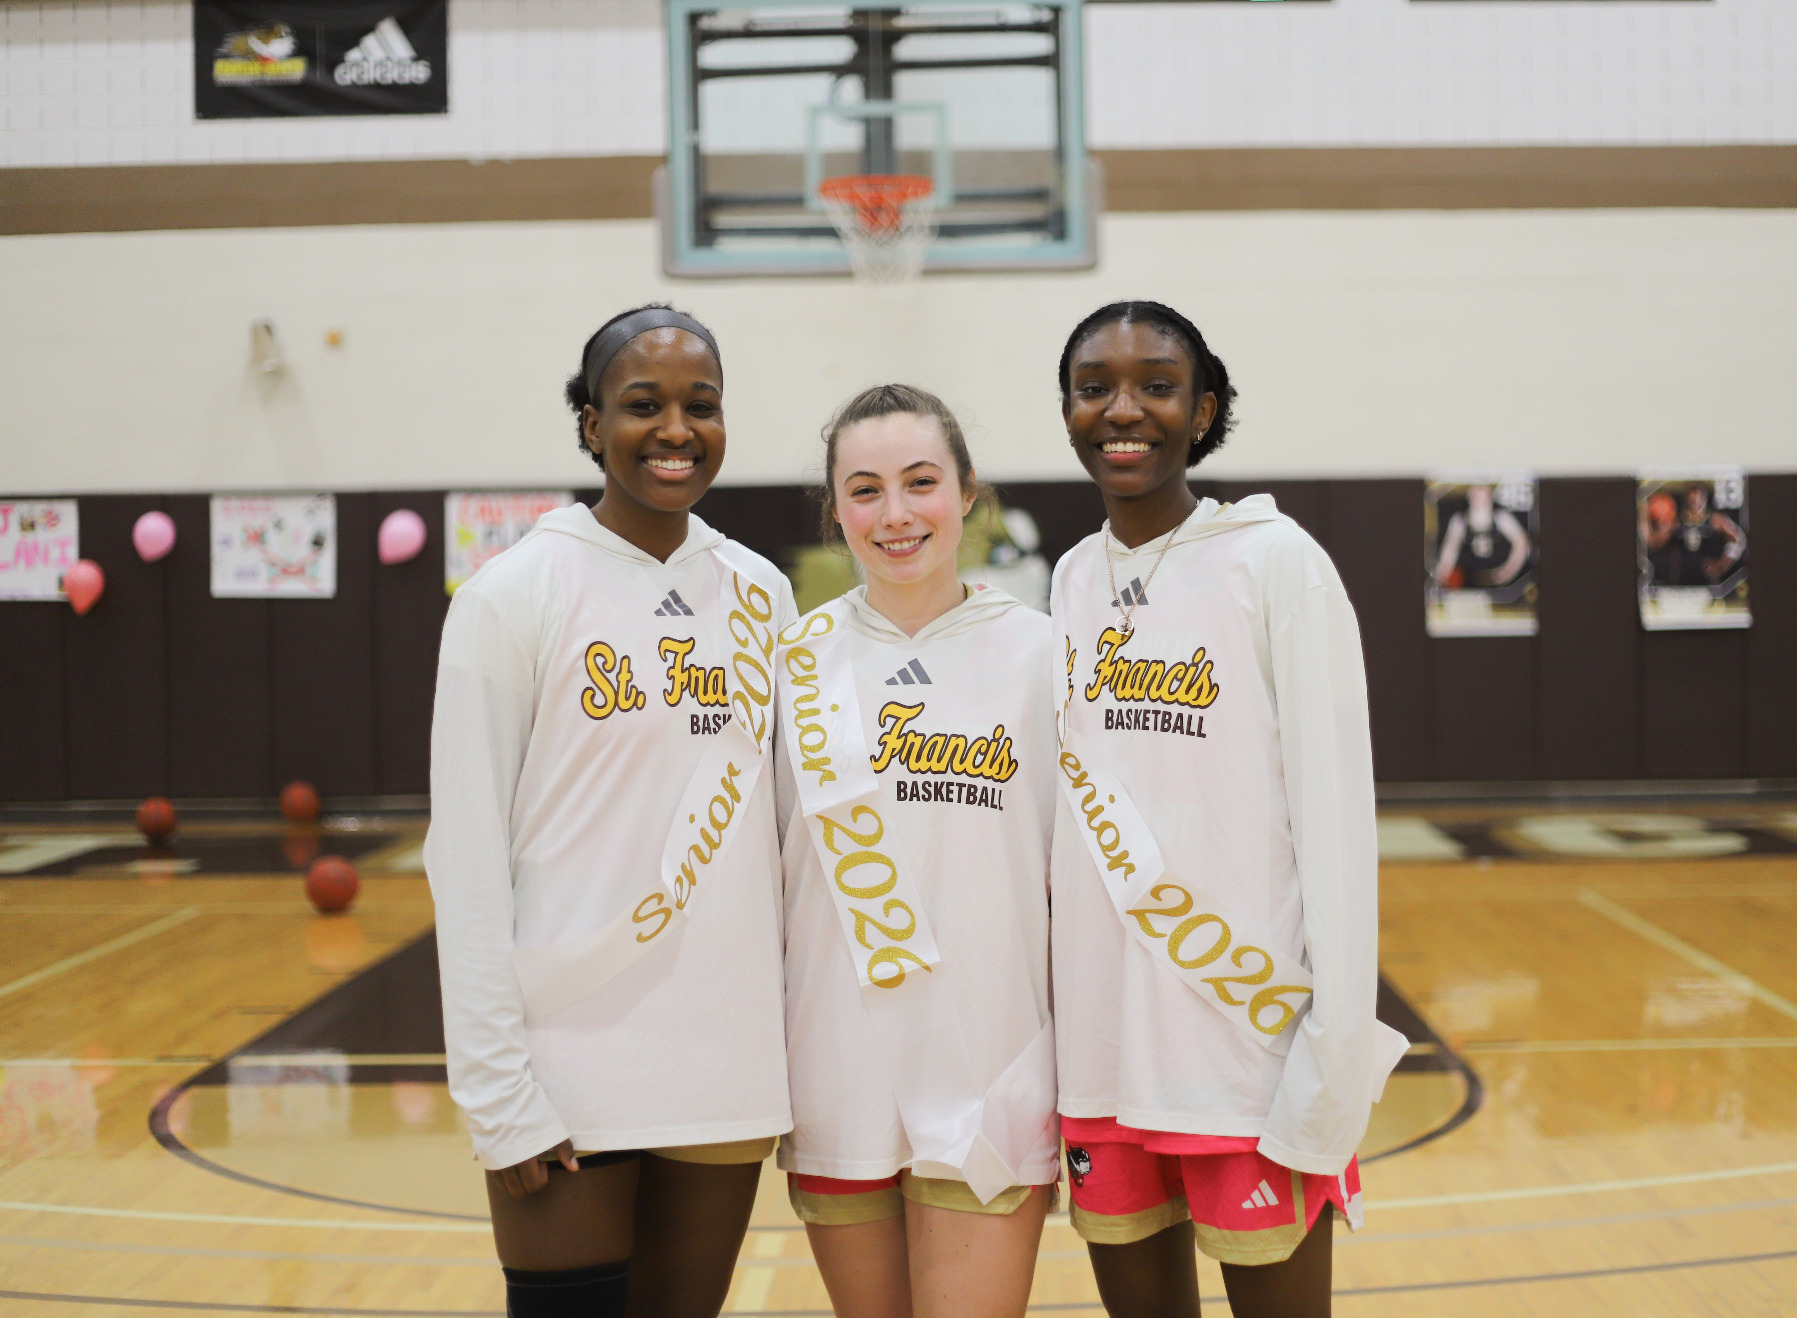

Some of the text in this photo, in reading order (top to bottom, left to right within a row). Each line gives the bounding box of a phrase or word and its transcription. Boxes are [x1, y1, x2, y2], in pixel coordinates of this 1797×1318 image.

[334, 56, 431, 86] adidas
[581, 641, 646, 720] St.
[1085, 627, 1219, 710] Francis
[632, 571, 773, 943] Senior 2026
[870, 701, 1018, 783] Francis
[1104, 708, 1207, 739] BASKETBALL
[778, 612, 932, 989] Senior 2026
[896, 780, 1003, 811] BASKETBALL
[1126, 884, 1313, 1036] 2026
